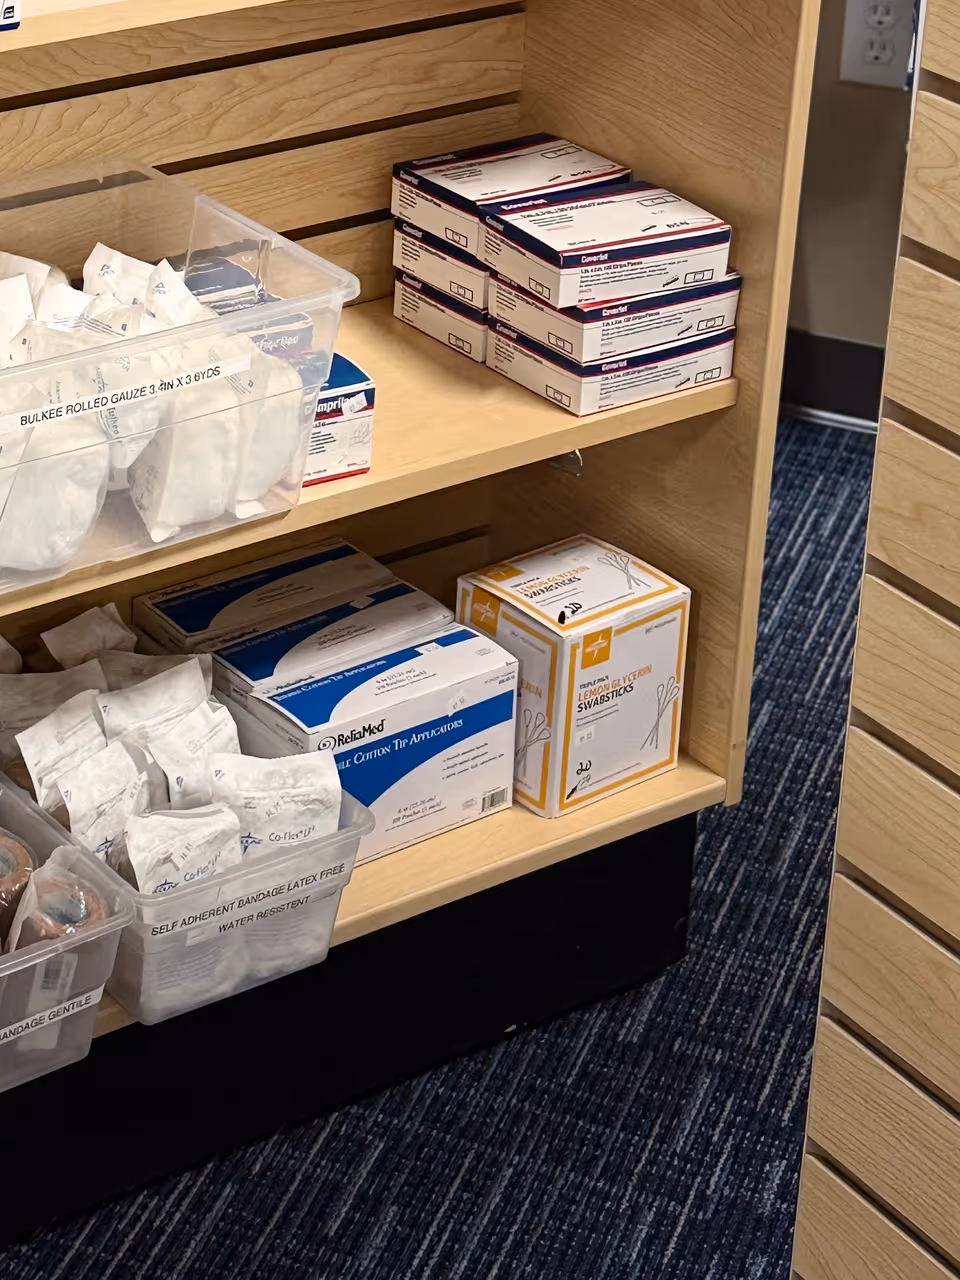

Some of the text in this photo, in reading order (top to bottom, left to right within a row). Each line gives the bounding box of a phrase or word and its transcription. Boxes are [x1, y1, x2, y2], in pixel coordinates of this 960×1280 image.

[581, 253, 608, 263] Coverlet
[602, 305, 629, 317] Coverlet
[601, 360, 627, 371] Coverlet
[20, 406, 63, 426] BULKEE
[66, 396, 109, 416] ROLLED
[110, 386, 147, 405] GAUZE
[176, 377, 185, 388] X
[577, 682, 634, 713] SWABSTICKS
[578, 684, 610, 701] LEMON
[337, 718, 386, 747] ReliaMed
[354, 719, 464, 763] COTTON TIP APPLICATORS
[151, 863, 345, 936] SELF ADHERENT BANDAGE LATEX FREE
[219, 896, 310, 933] WATER RESISTENT
[48, 995, 91, 1021] GENTILE
